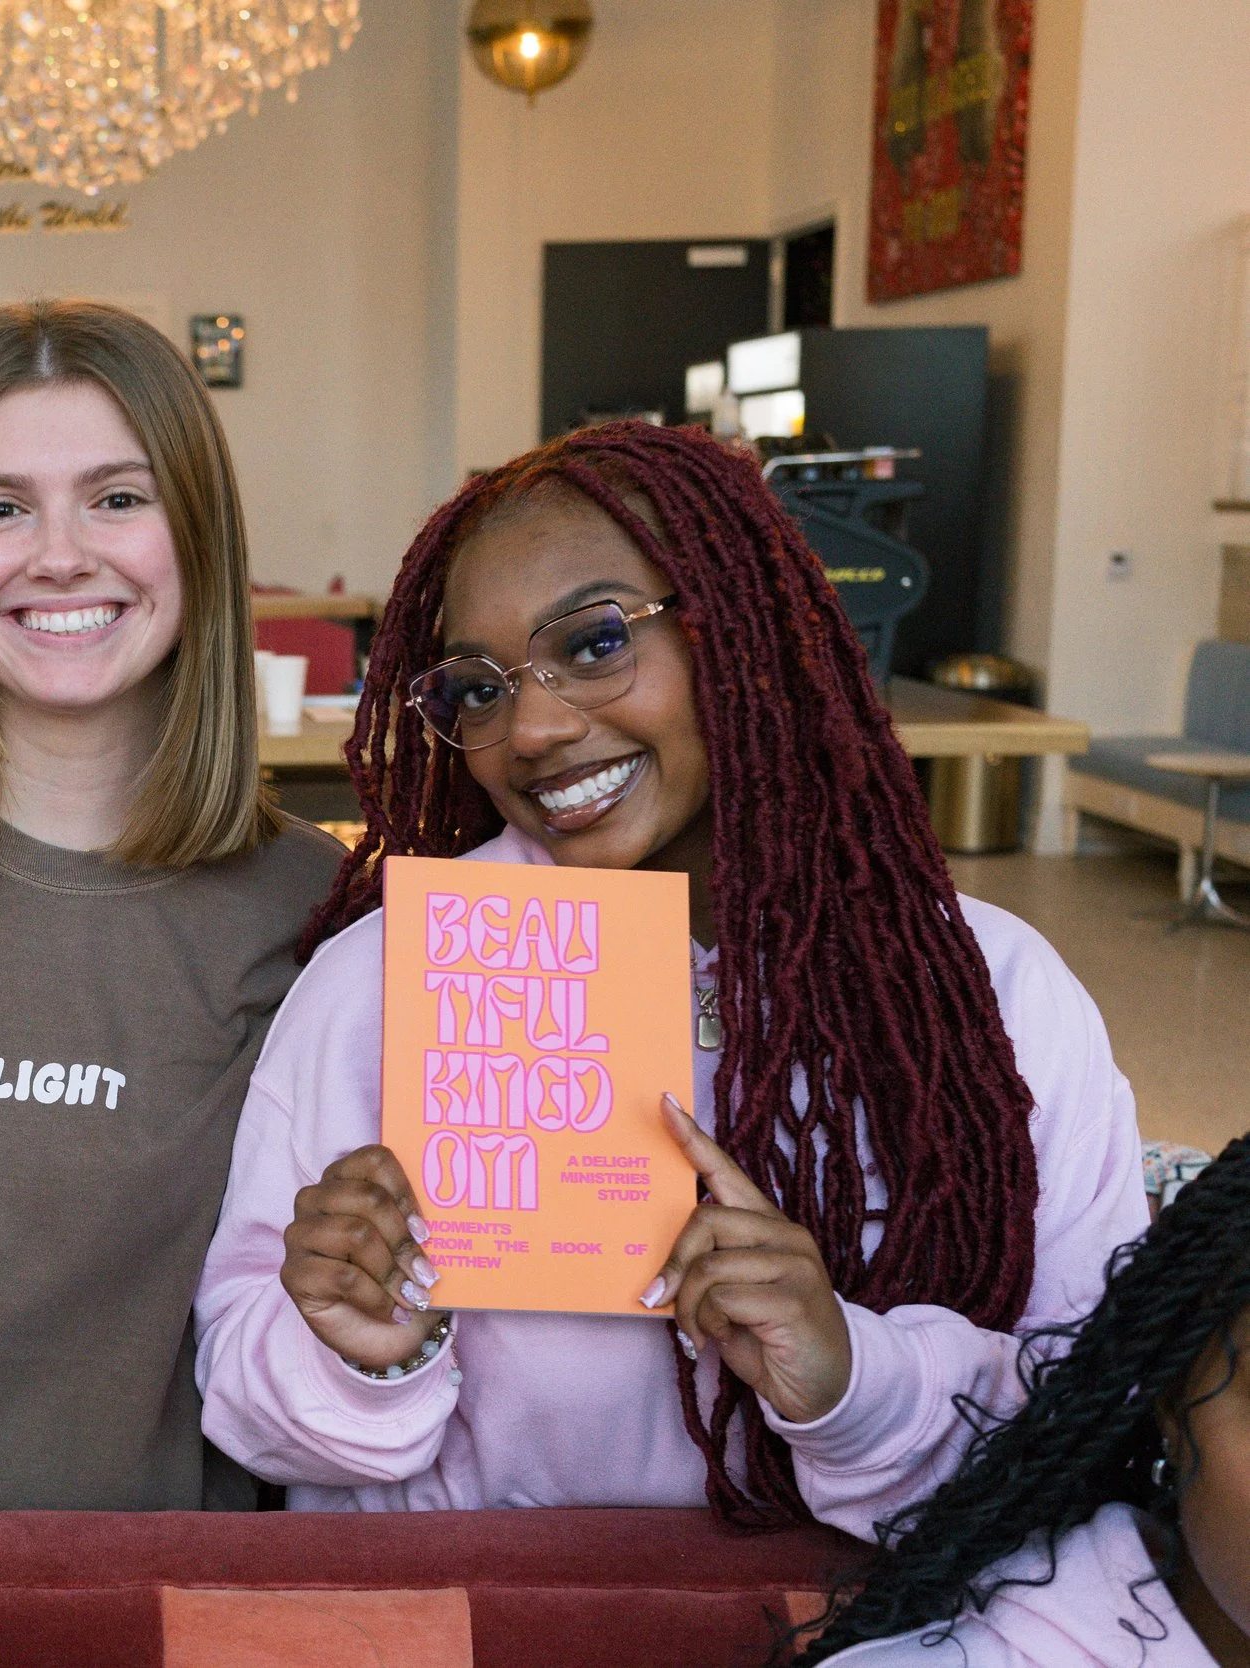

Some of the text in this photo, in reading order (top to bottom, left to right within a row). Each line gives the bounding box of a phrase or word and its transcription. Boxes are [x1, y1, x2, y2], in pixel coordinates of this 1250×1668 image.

[425, 892, 599, 974] BEAU
[424, 970, 610, 1053] TIFUL
[422, 1049, 614, 1133] KINGD
[567, 1155, 651, 1169] A DELIGHT
[422, 1130, 539, 1212] OM
[560, 1171, 651, 1185] MINISTRIES
[597, 1189, 651, 1201] STUDY
[425, 1219, 512, 1235] MOMENTS
[494, 1240, 530, 1253] THE
[550, 1242, 604, 1254] BOOK
[623, 1243, 649, 1256] OF
